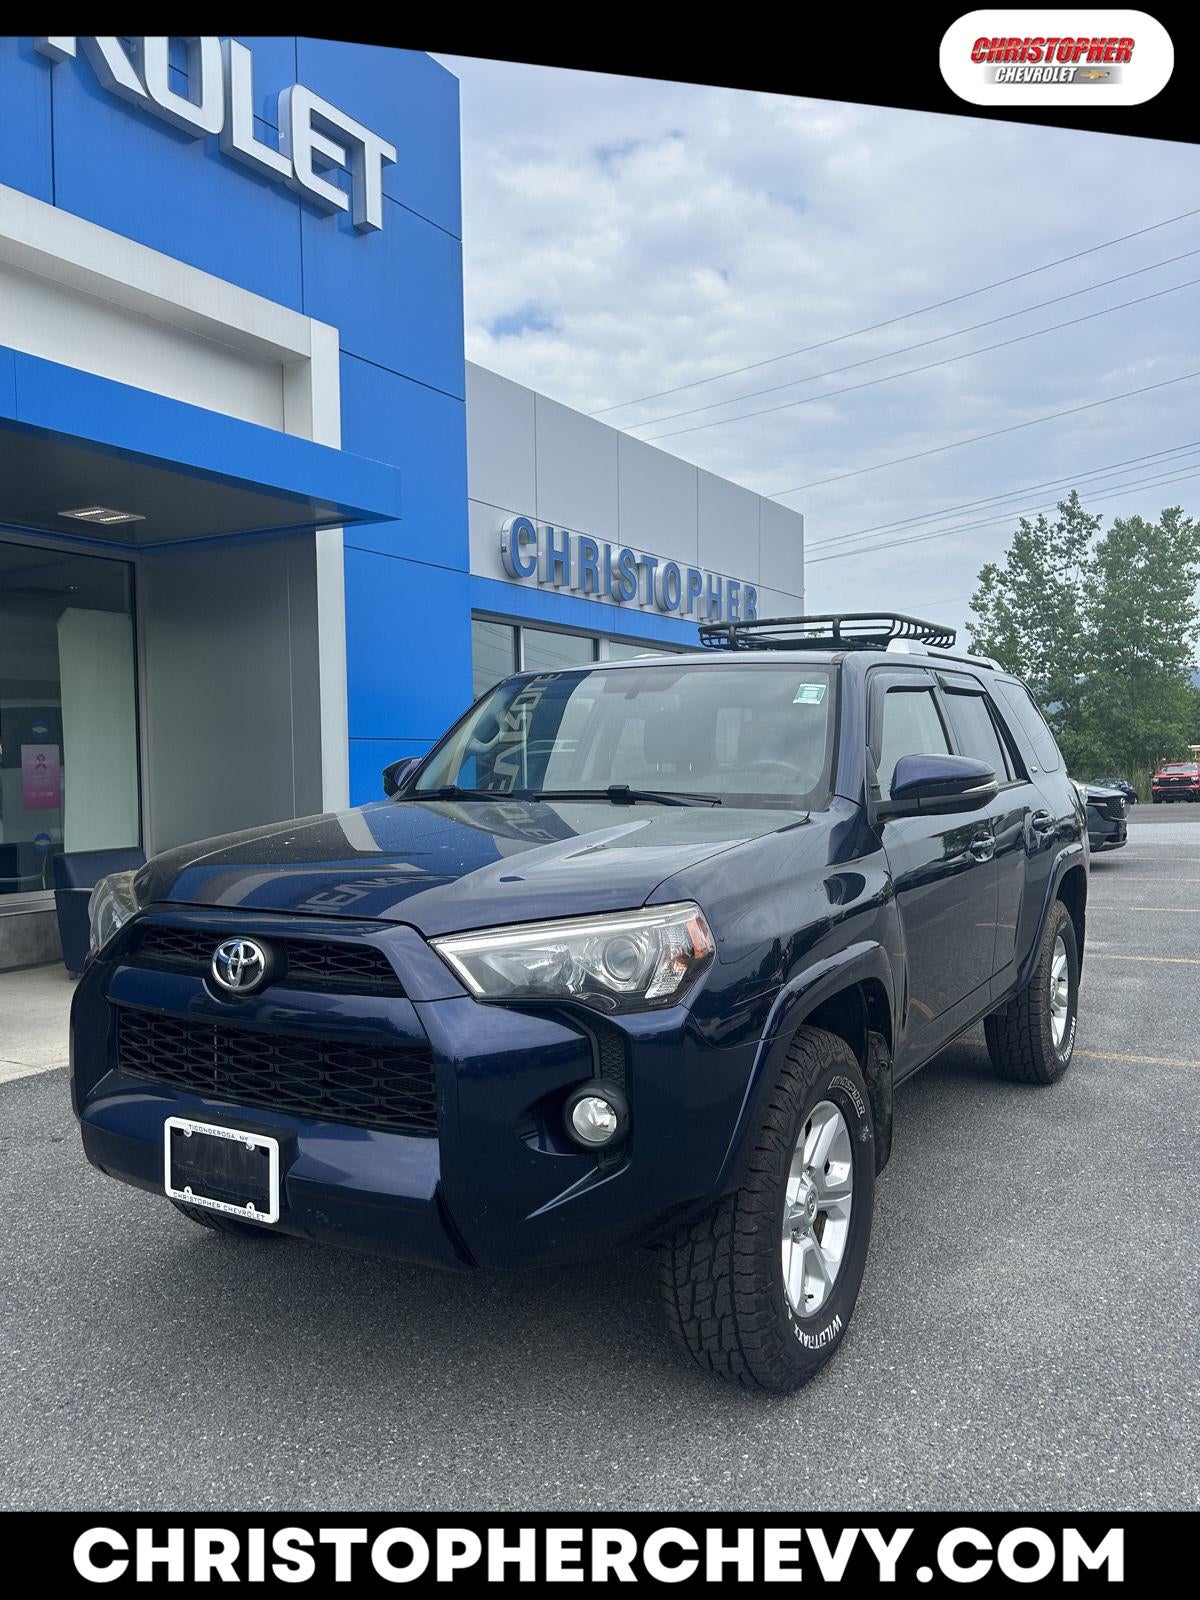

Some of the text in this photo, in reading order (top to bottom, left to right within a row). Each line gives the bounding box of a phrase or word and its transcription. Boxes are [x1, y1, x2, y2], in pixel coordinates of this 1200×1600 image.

[501, 516, 758, 623] CHRISTOPHER
[173, 1190, 266, 1221] CHRISTOPHER CHEVROLET
